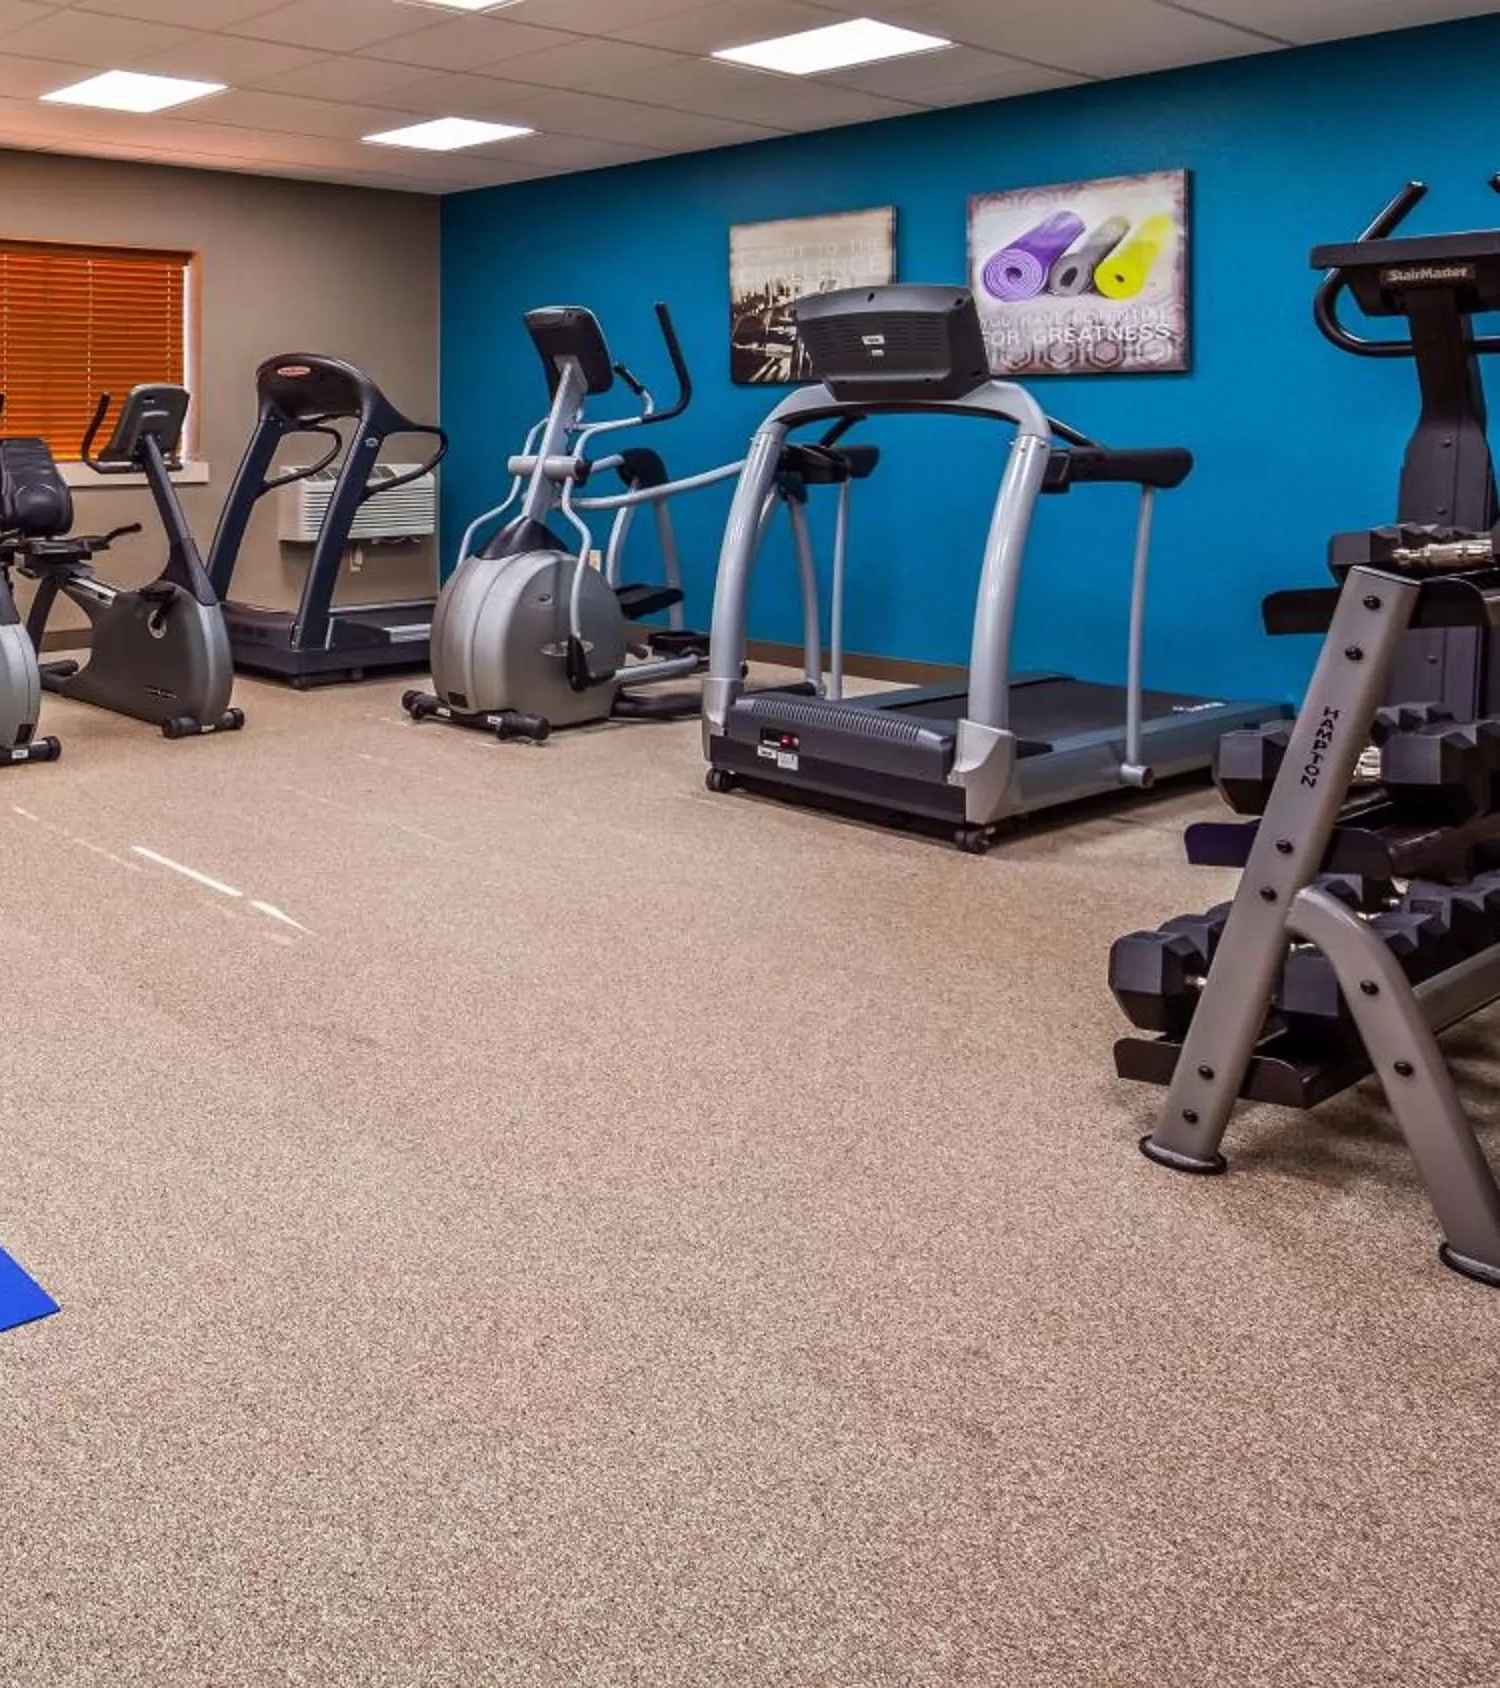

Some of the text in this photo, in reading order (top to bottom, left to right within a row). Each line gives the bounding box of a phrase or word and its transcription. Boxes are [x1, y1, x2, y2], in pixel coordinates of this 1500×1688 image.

[1386, 266, 1468, 282] StairMaster
[982, 322, 1172, 346] FOR GREATNESS
[1300, 706, 1340, 789] HAMPTON
